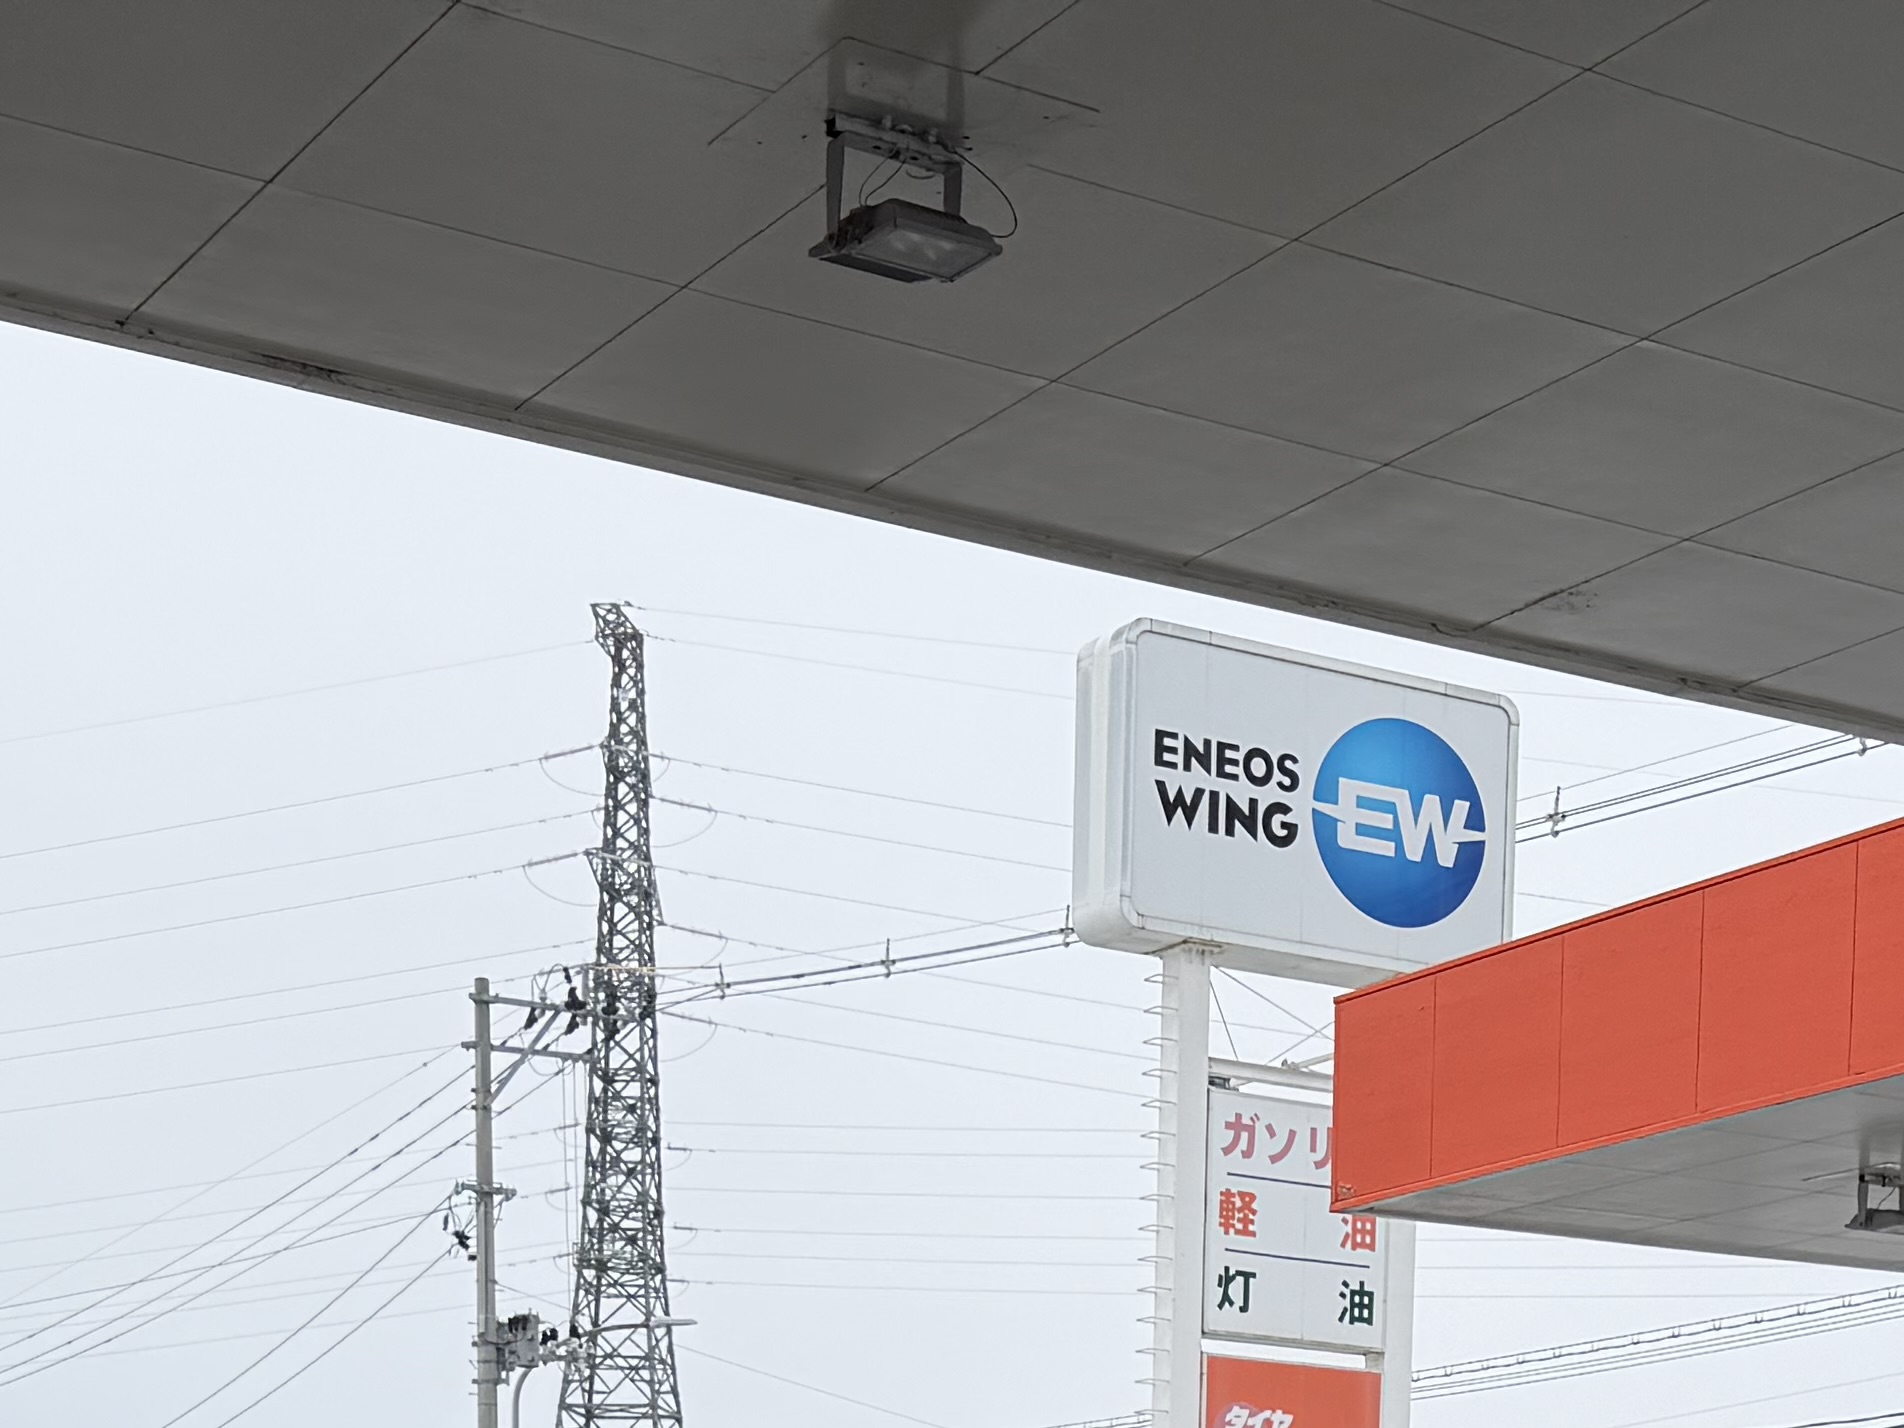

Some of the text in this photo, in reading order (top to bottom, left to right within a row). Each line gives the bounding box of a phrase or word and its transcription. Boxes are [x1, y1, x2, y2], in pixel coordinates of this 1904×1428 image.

[1153, 728, 1301, 793] ENEOS
[1154, 779, 1299, 849] WING
[1220, 1111, 1333, 1169] ガソリ
